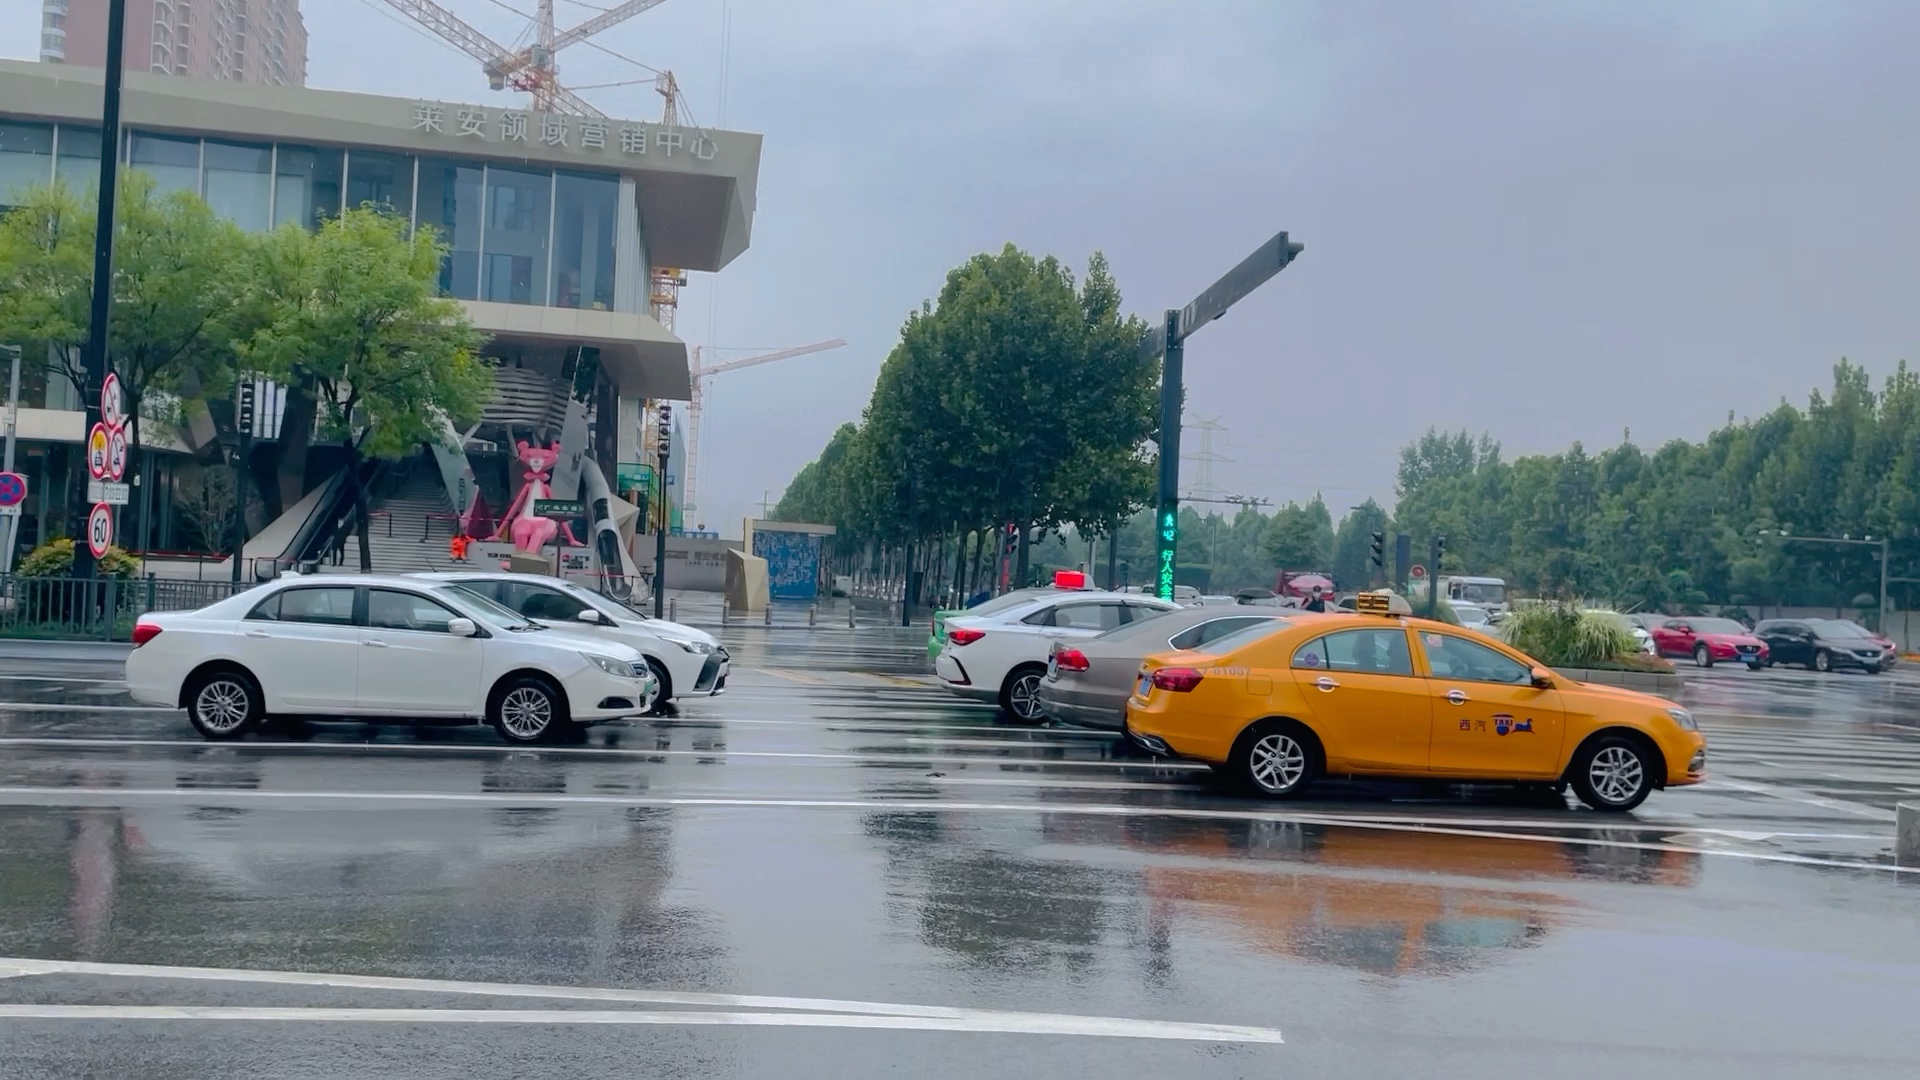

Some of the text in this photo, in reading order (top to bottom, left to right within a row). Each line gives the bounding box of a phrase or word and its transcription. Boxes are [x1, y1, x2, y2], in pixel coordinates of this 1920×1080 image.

[412, 104, 719, 161] 莱安领域营销中心
[94, 517, 108, 543] 60
